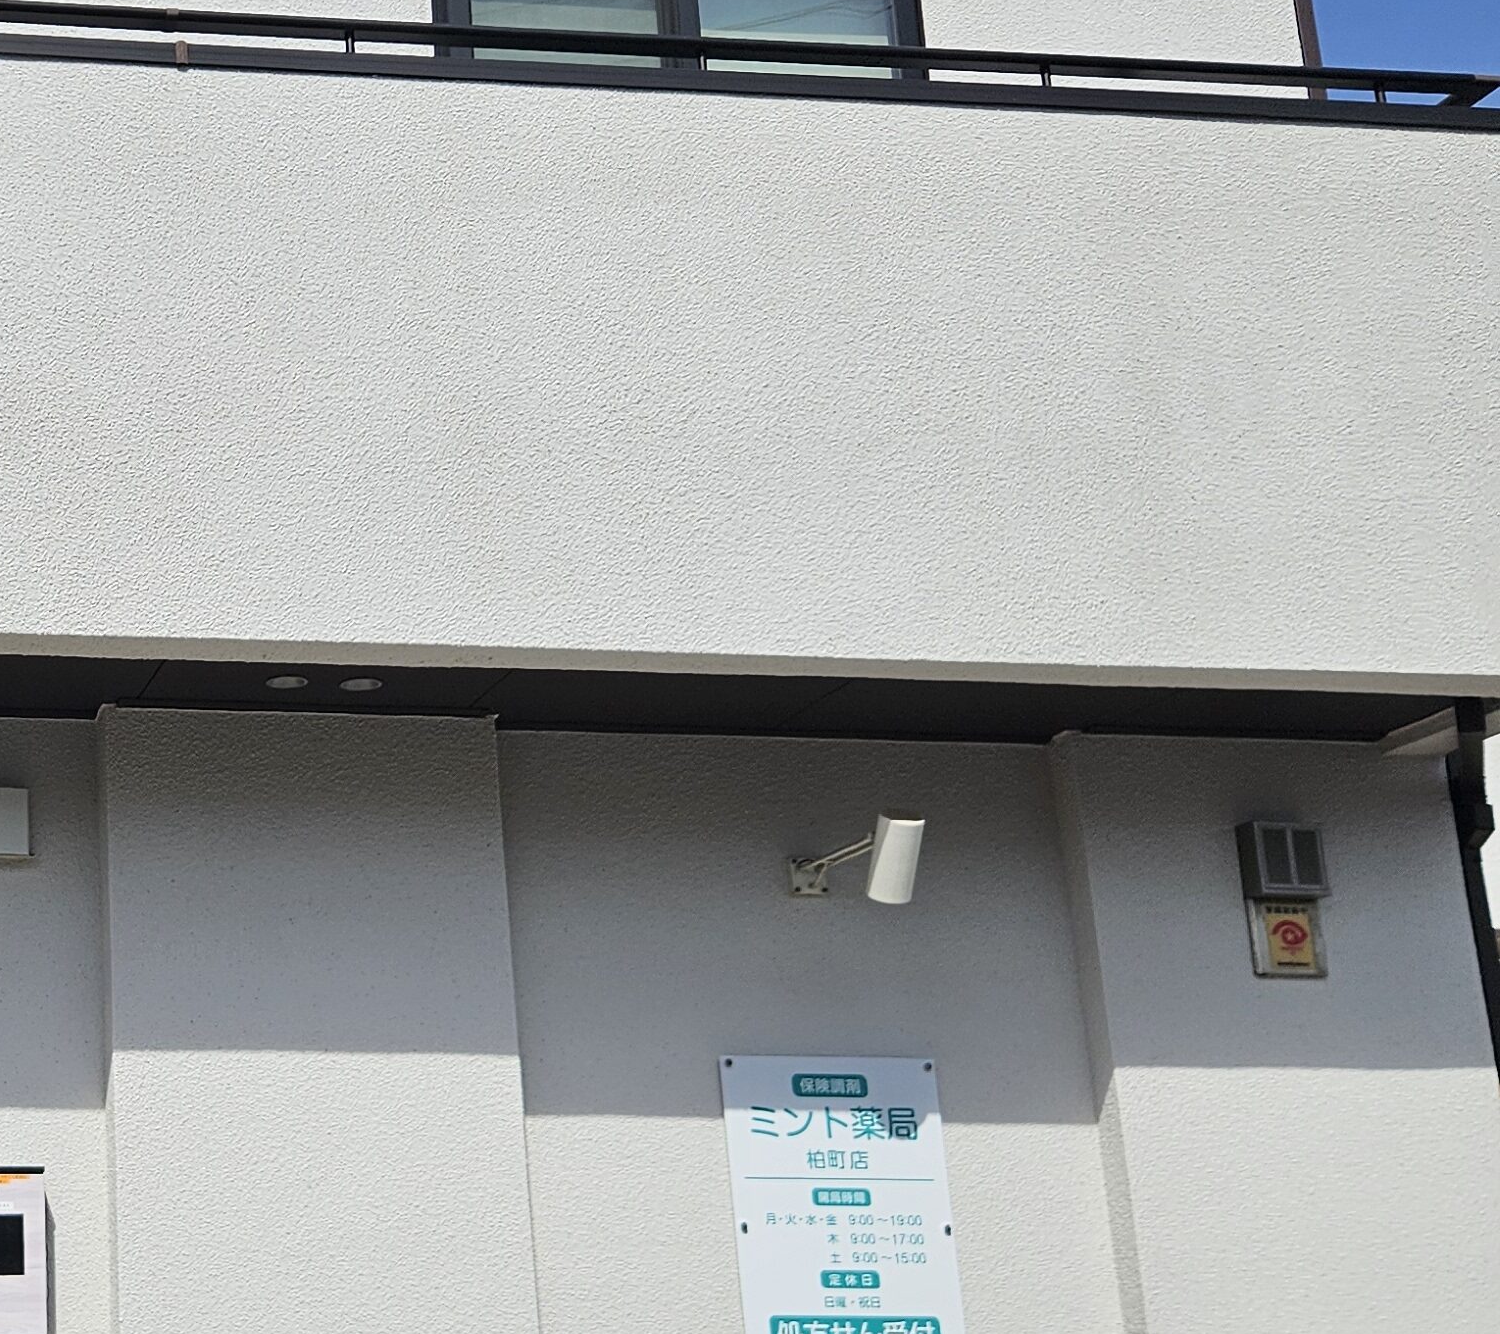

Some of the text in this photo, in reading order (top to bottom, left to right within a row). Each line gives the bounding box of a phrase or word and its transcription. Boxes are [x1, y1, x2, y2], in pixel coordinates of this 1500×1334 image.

[799, 1077, 862, 1095] 保険調剤
[750, 1106, 918, 1140] ミント薬局
[806, 1149, 869, 1169] 柏町店
[827, 1233, 840, 1245] 木
[831, 1252, 842, 1264] 土
